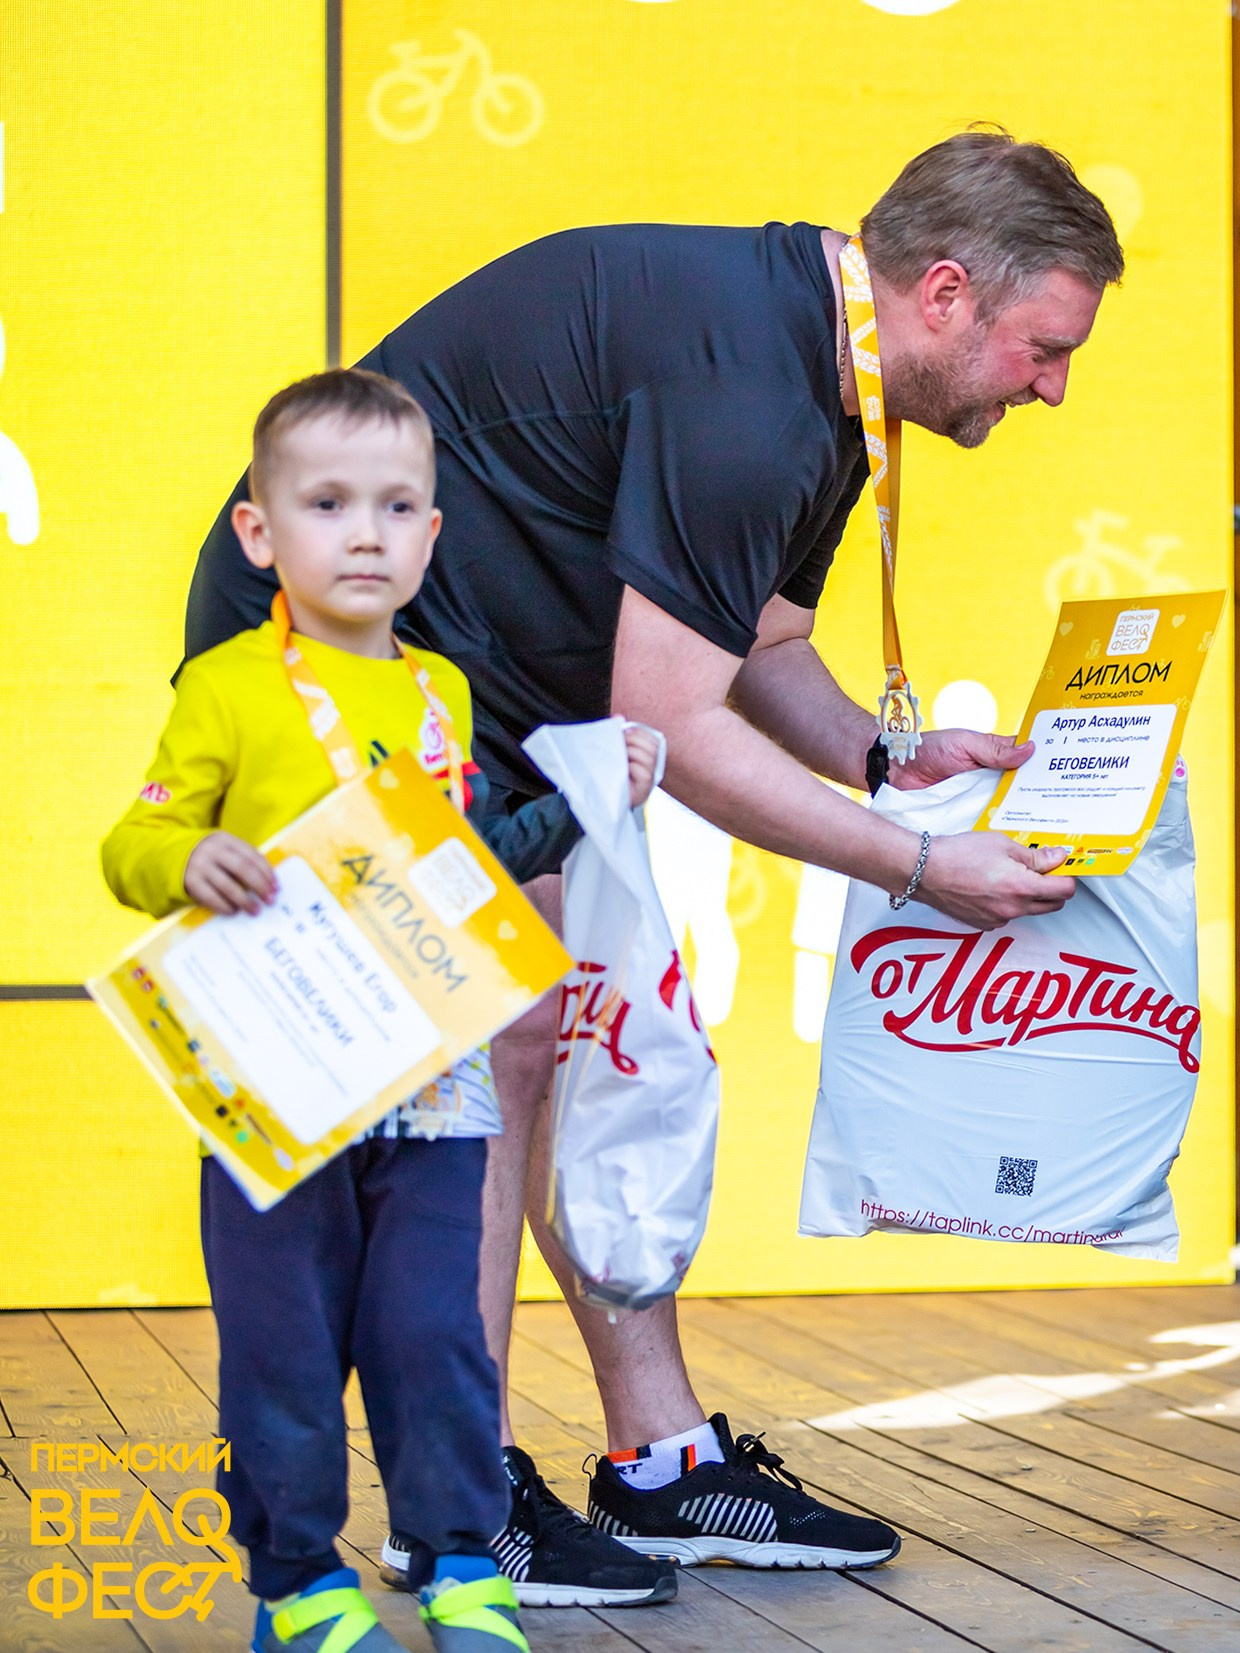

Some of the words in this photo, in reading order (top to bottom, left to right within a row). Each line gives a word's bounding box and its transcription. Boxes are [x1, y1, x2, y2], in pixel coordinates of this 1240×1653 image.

[1065, 661, 1173, 691] ДИПЛОМ
[1080, 690, 1144, 700] награждается
[1051, 716, 1086, 731] Артур
[1088, 715, 1151, 729] Асхадулин
[1048, 756, 1130, 770] БЕГОВЕЛИКИ
[341, 854, 469, 993] ДИПЛОМ
[264, 936, 355, 1047] БЕГОВЕЛИКИ
[364, 971, 398, 1014] Егор
[871, 952, 946, 1000] от
[850, 926, 1201, 1074] Мартина
